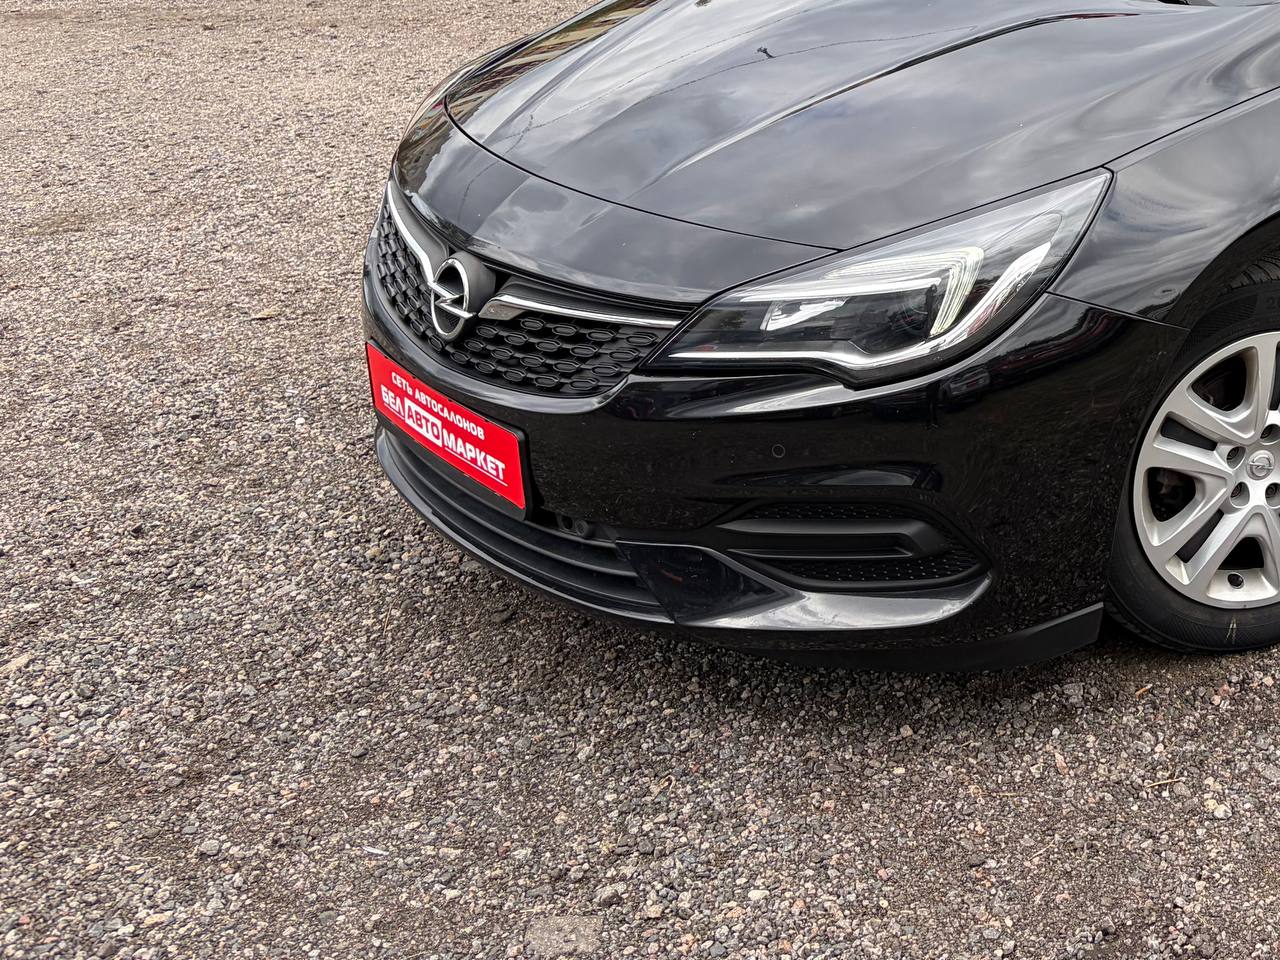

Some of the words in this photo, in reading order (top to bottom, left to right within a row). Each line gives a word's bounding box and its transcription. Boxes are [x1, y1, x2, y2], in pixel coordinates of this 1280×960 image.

[380, 385, 404, 416] БЕЛ
[406, 403, 441, 443] АВТО
[442, 430, 506, 481] МАРКЕТ
[391, 371, 413, 396] СЕТЬ
[415, 388, 485, 440] АВТОСАЛОНОВ
